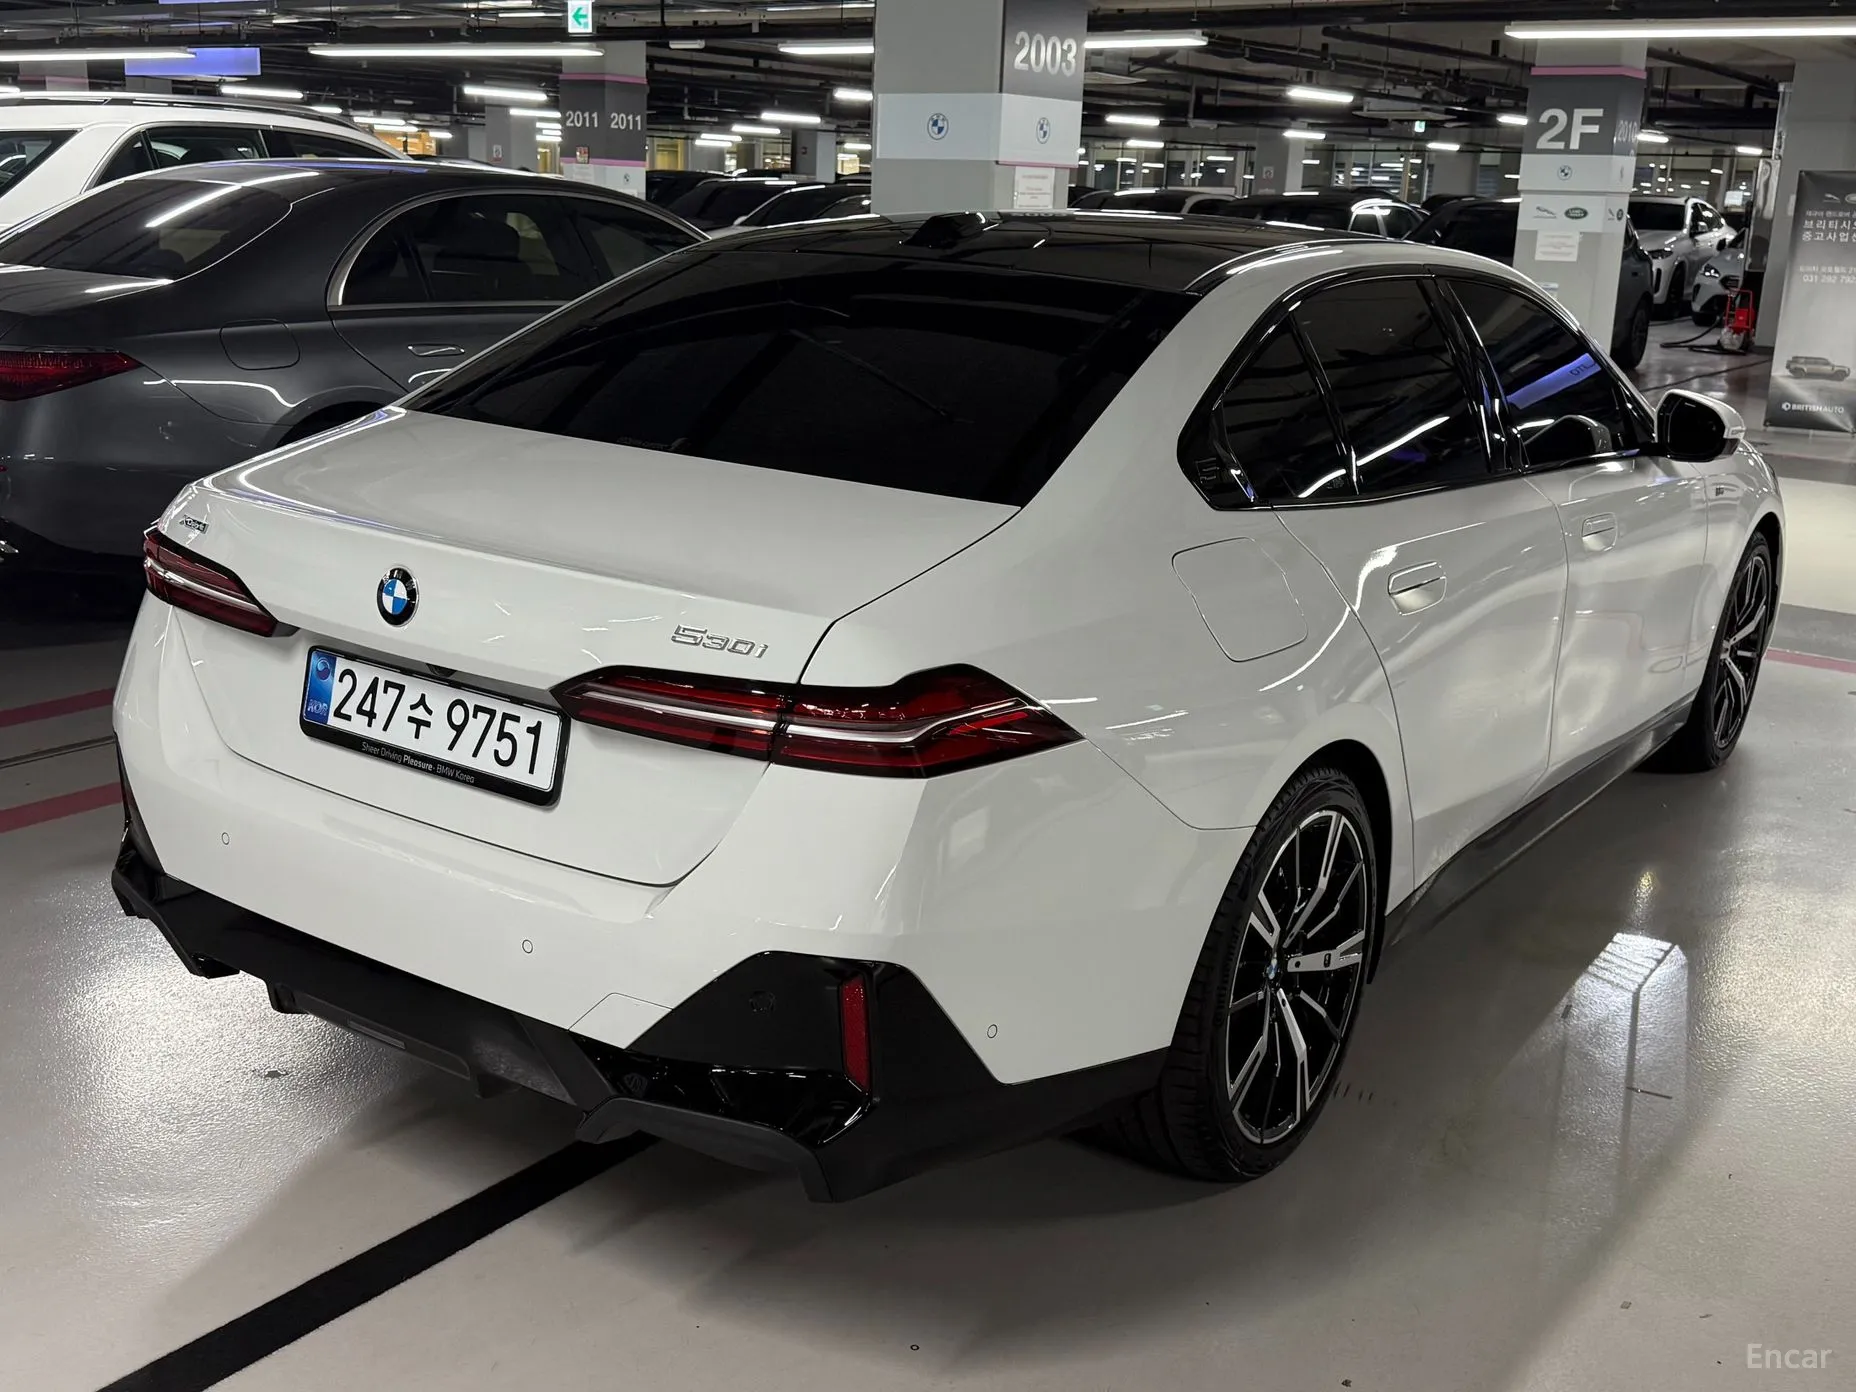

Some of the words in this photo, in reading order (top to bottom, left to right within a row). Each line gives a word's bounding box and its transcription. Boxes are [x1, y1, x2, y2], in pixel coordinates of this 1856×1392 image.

[1014, 31, 1077, 77] 2003
[565, 110, 599, 128] 2011
[610, 112, 642, 130] 2011
[1536, 108, 1604, 150] 2F
[671, 623, 769, 659] 530i
[307, 699, 328, 716] KOR
[333, 668, 433, 739] 247수
[446, 698, 543, 775] 9751
[361, 741, 380, 755] Sheer
[380, 747, 402, 763] Driving
[436, 763, 455, 777] BMW
[455, 769, 475, 784] Korea
